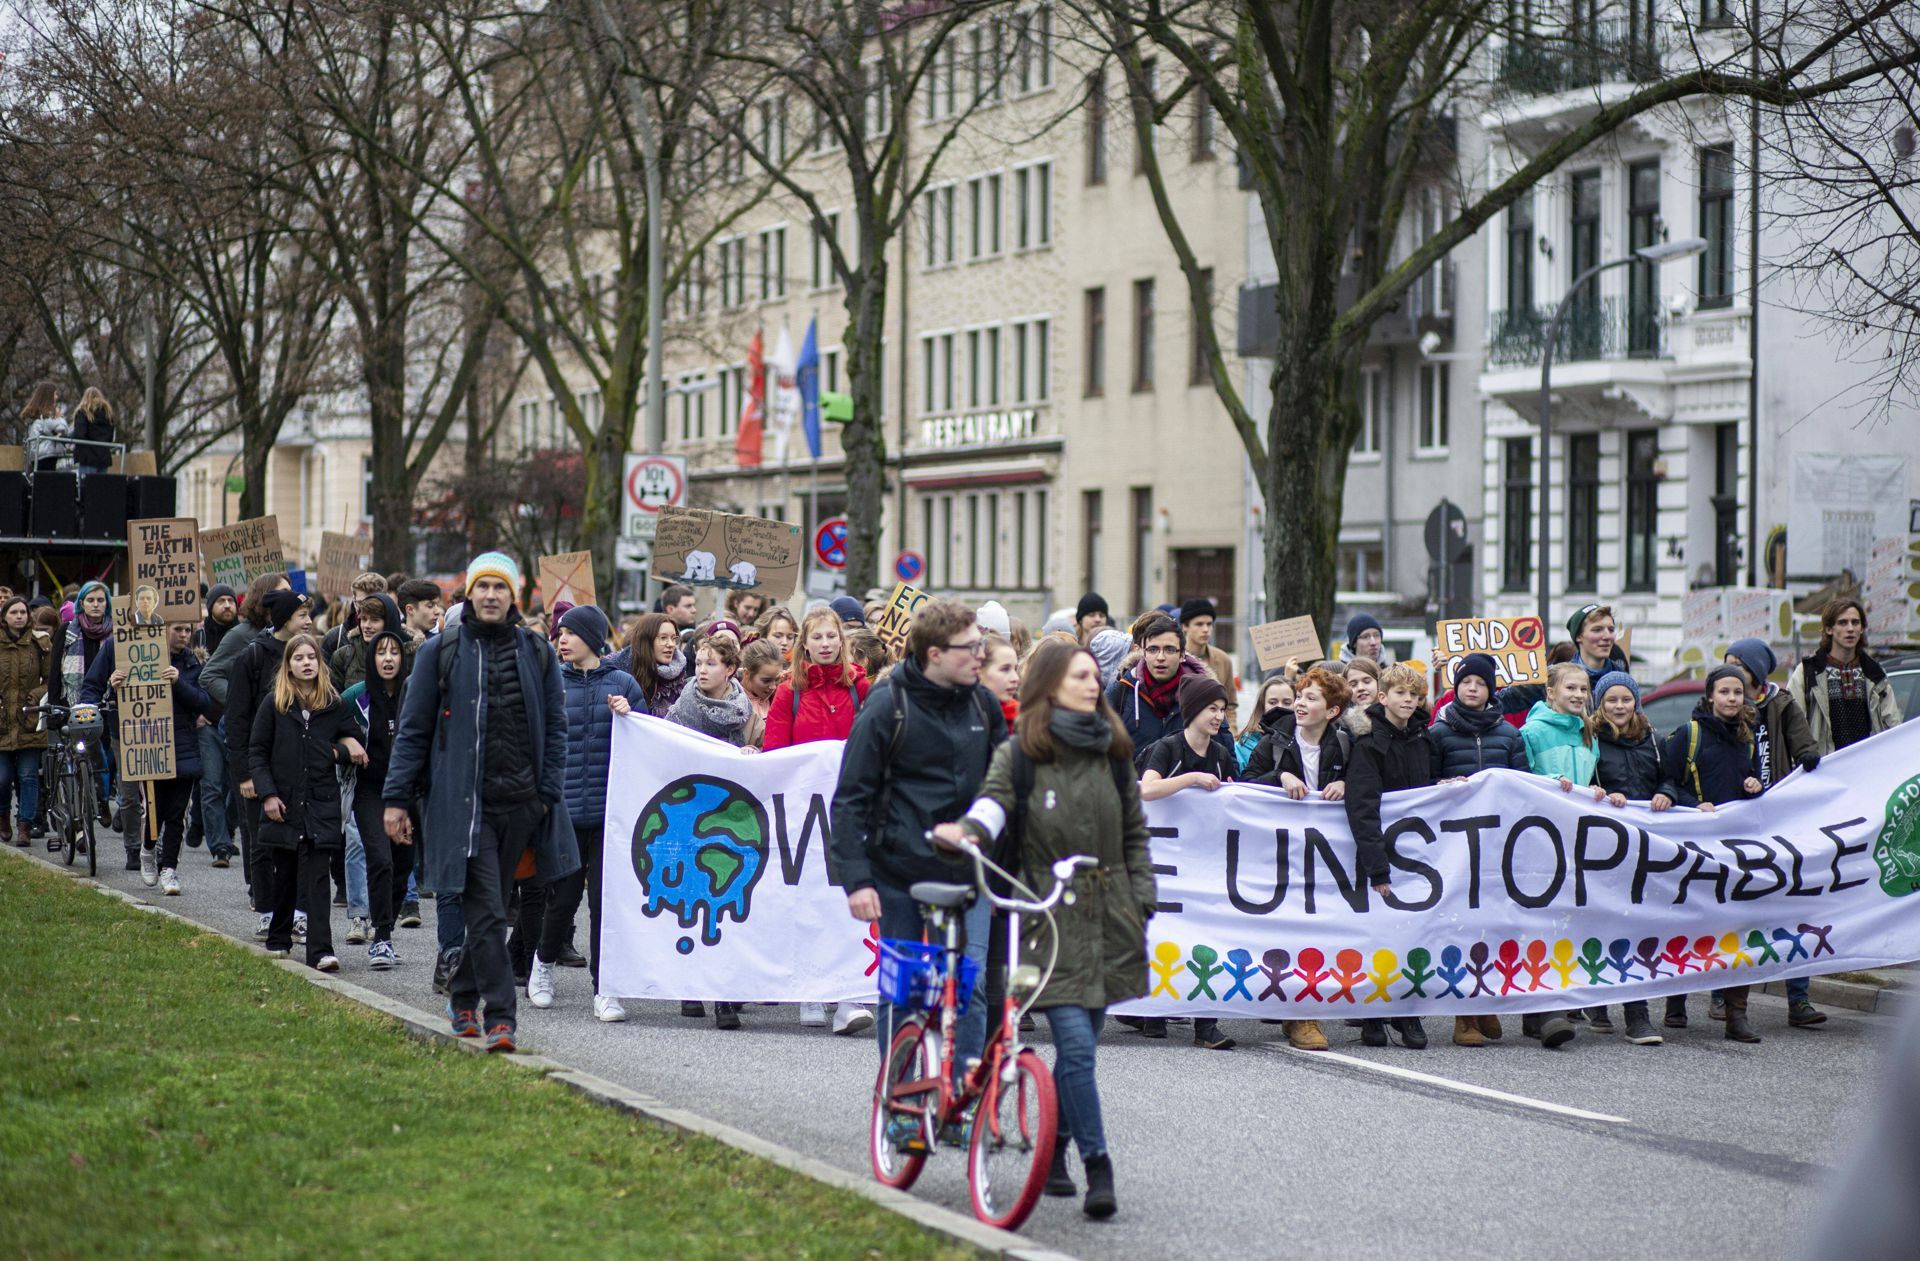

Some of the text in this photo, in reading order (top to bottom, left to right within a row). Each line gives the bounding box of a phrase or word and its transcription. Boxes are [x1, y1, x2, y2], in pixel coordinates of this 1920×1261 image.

[921, 409, 1038, 448] RESTAURANT
[139, 525, 170, 541] THE
[233, 524, 251, 539] mit
[145, 537, 193, 555] EARTH
[158, 554, 171, 564] IS
[212, 548, 284, 573] HOCH mit dem
[138, 562, 196, 579] HOTTER
[155, 576, 188, 589] THAN
[164, 589, 195, 607] LEO
[894, 585, 929, 612] EC
[882, 606, 912, 637] NO
[117, 625, 163, 643] DIE OF
[1445, 620, 1510, 652] END
[128, 643, 160, 664] OLD
[127, 664, 161, 683] AGE
[1446, 650, 1540, 685] CAL!
[120, 683, 167, 702] I'LL DIE
[132, 702, 156, 718] OF
[122, 717, 171, 746] CLIMATE
[126, 745, 172, 776] CHANGE
[1877, 779, 1920, 884] FRIDAYS FO
[1226, 815, 1870, 915] UNSTOPPABLE
